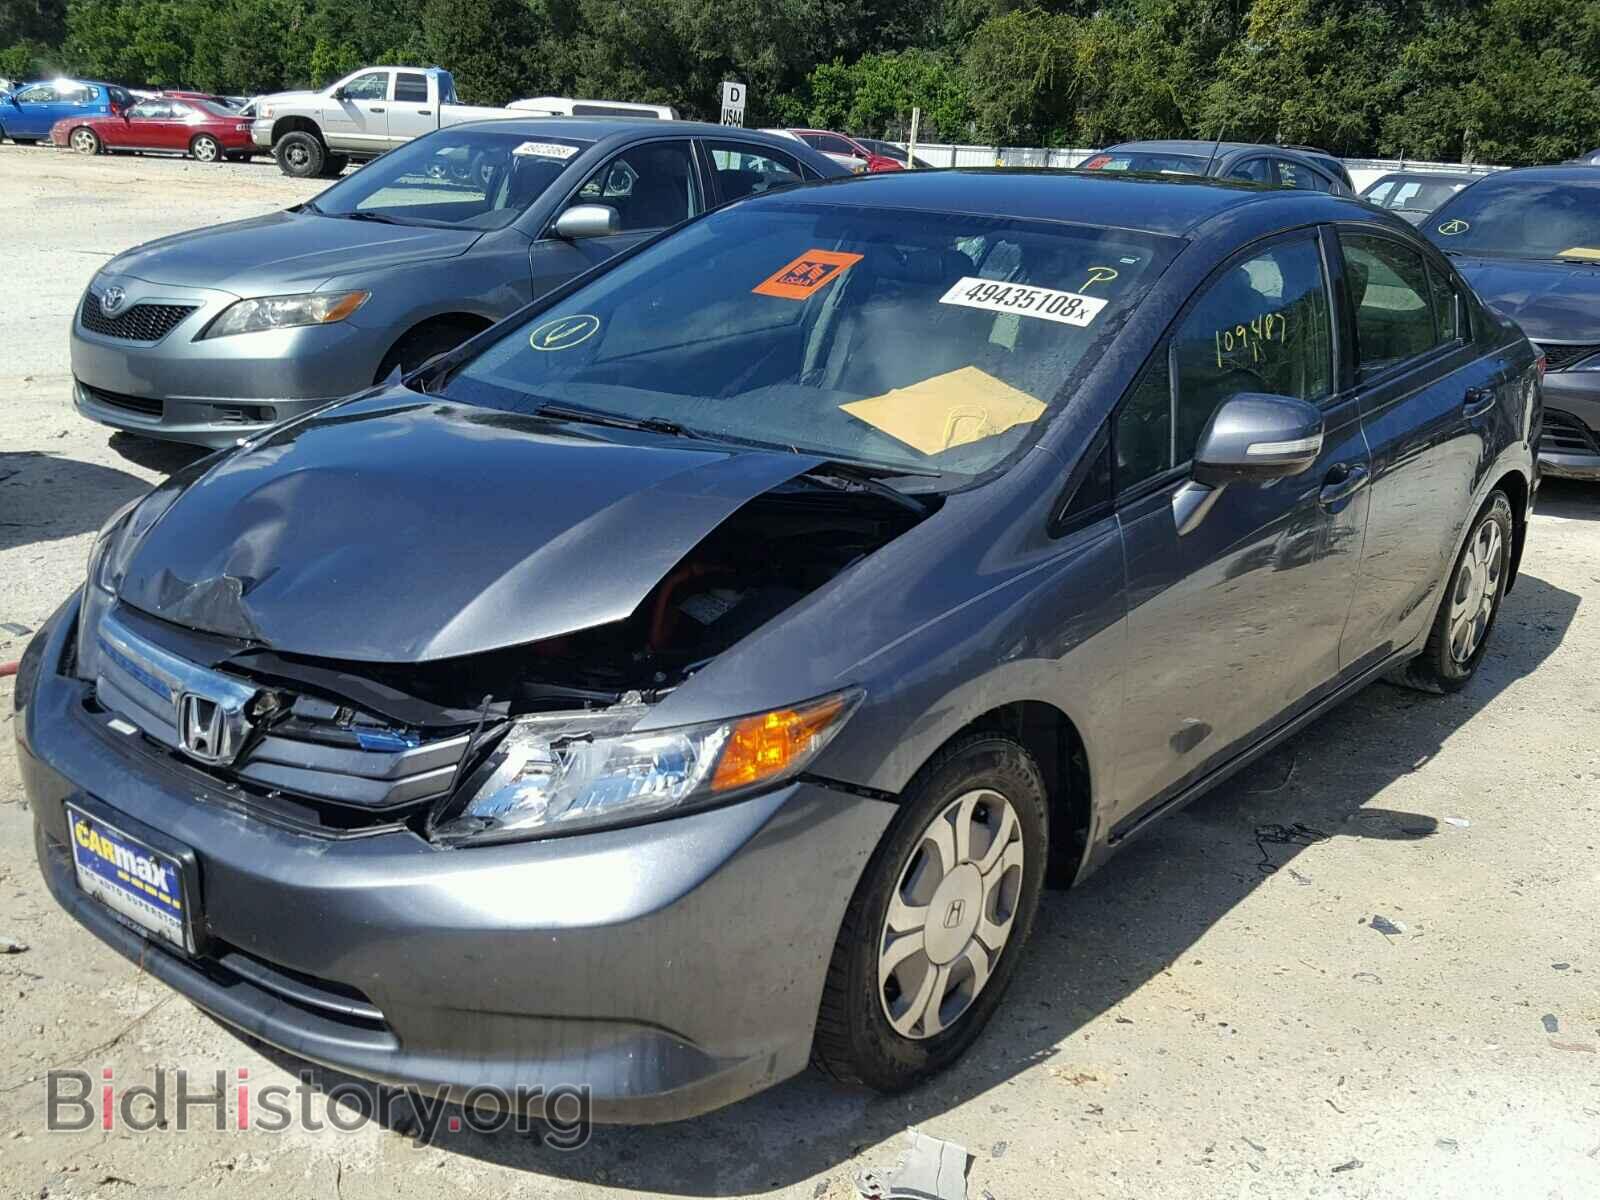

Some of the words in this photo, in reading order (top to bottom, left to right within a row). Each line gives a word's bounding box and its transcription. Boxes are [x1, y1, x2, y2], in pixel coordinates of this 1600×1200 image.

[730, 88, 740, 102] D
[723, 109, 742, 127] USAA
[1077, 267, 1119, 294] P
